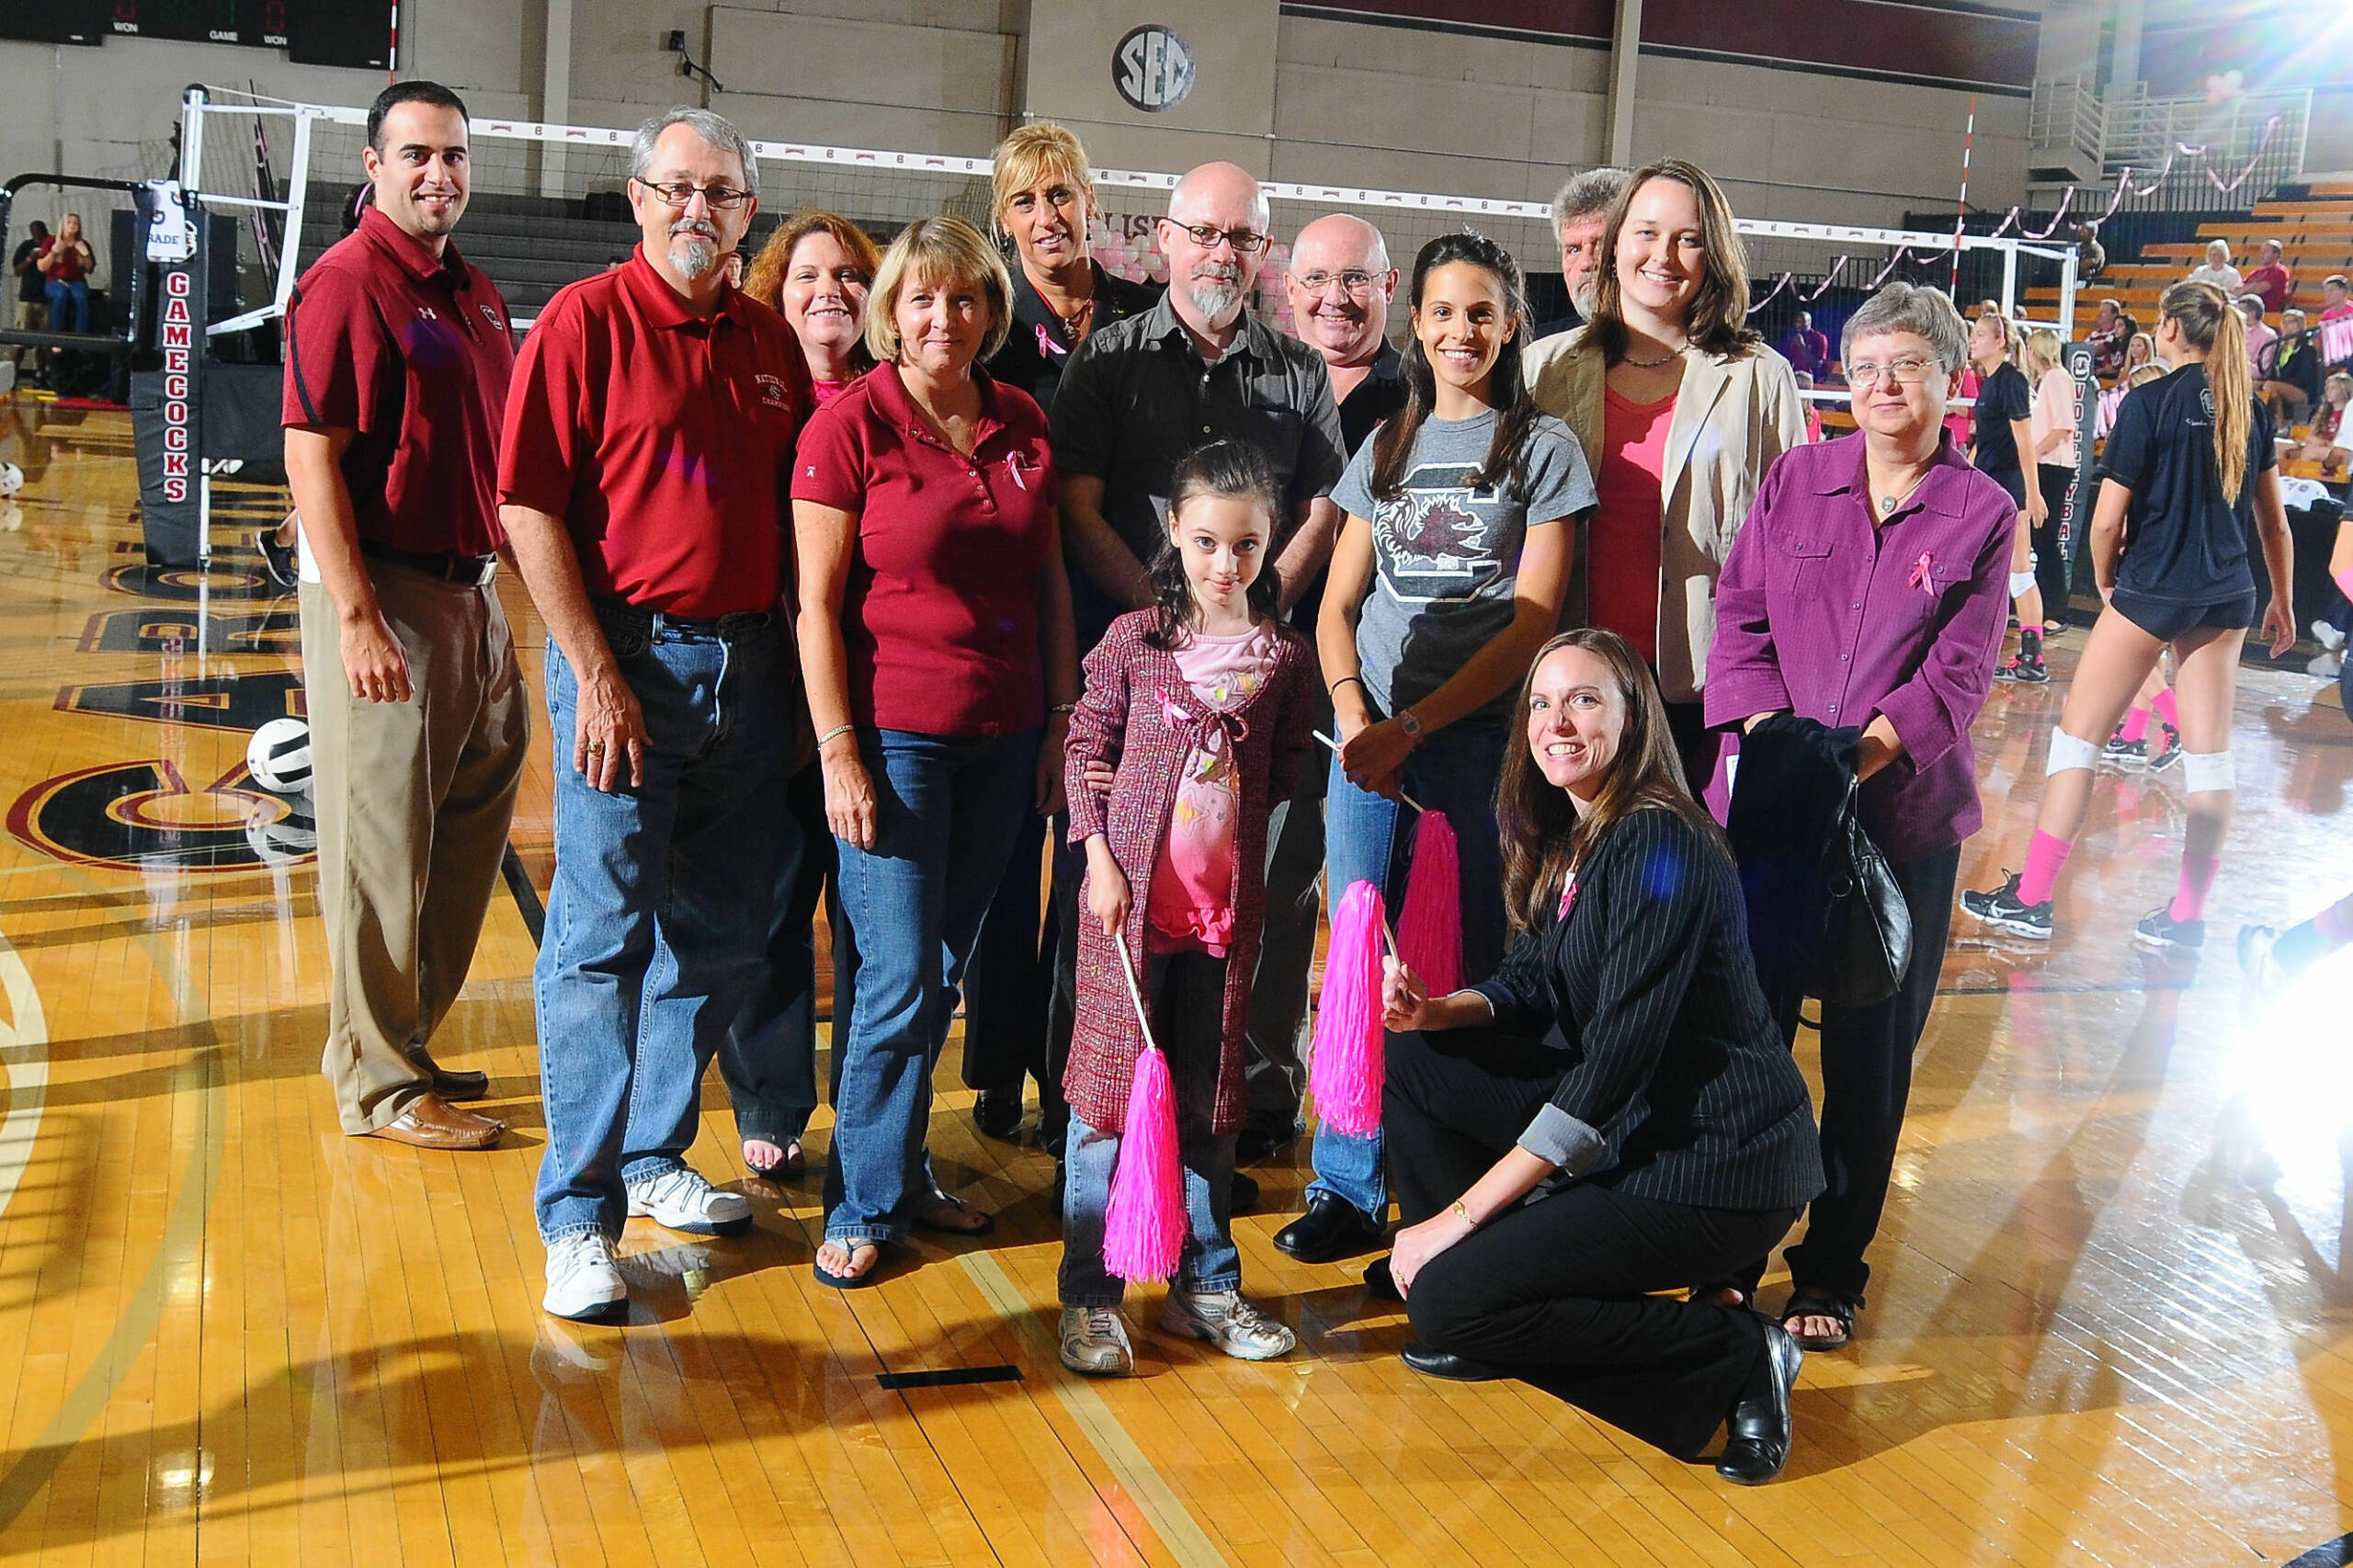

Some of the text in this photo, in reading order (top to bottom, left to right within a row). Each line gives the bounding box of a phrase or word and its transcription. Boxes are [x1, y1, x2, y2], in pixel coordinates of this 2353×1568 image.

[113, 21, 139, 33] WON
[209, 29, 238, 42] GAME
[263, 34, 288, 46] WON
[1120, 31, 1188, 106] SEC
[163, 271, 191, 503] GAMECOCKS
